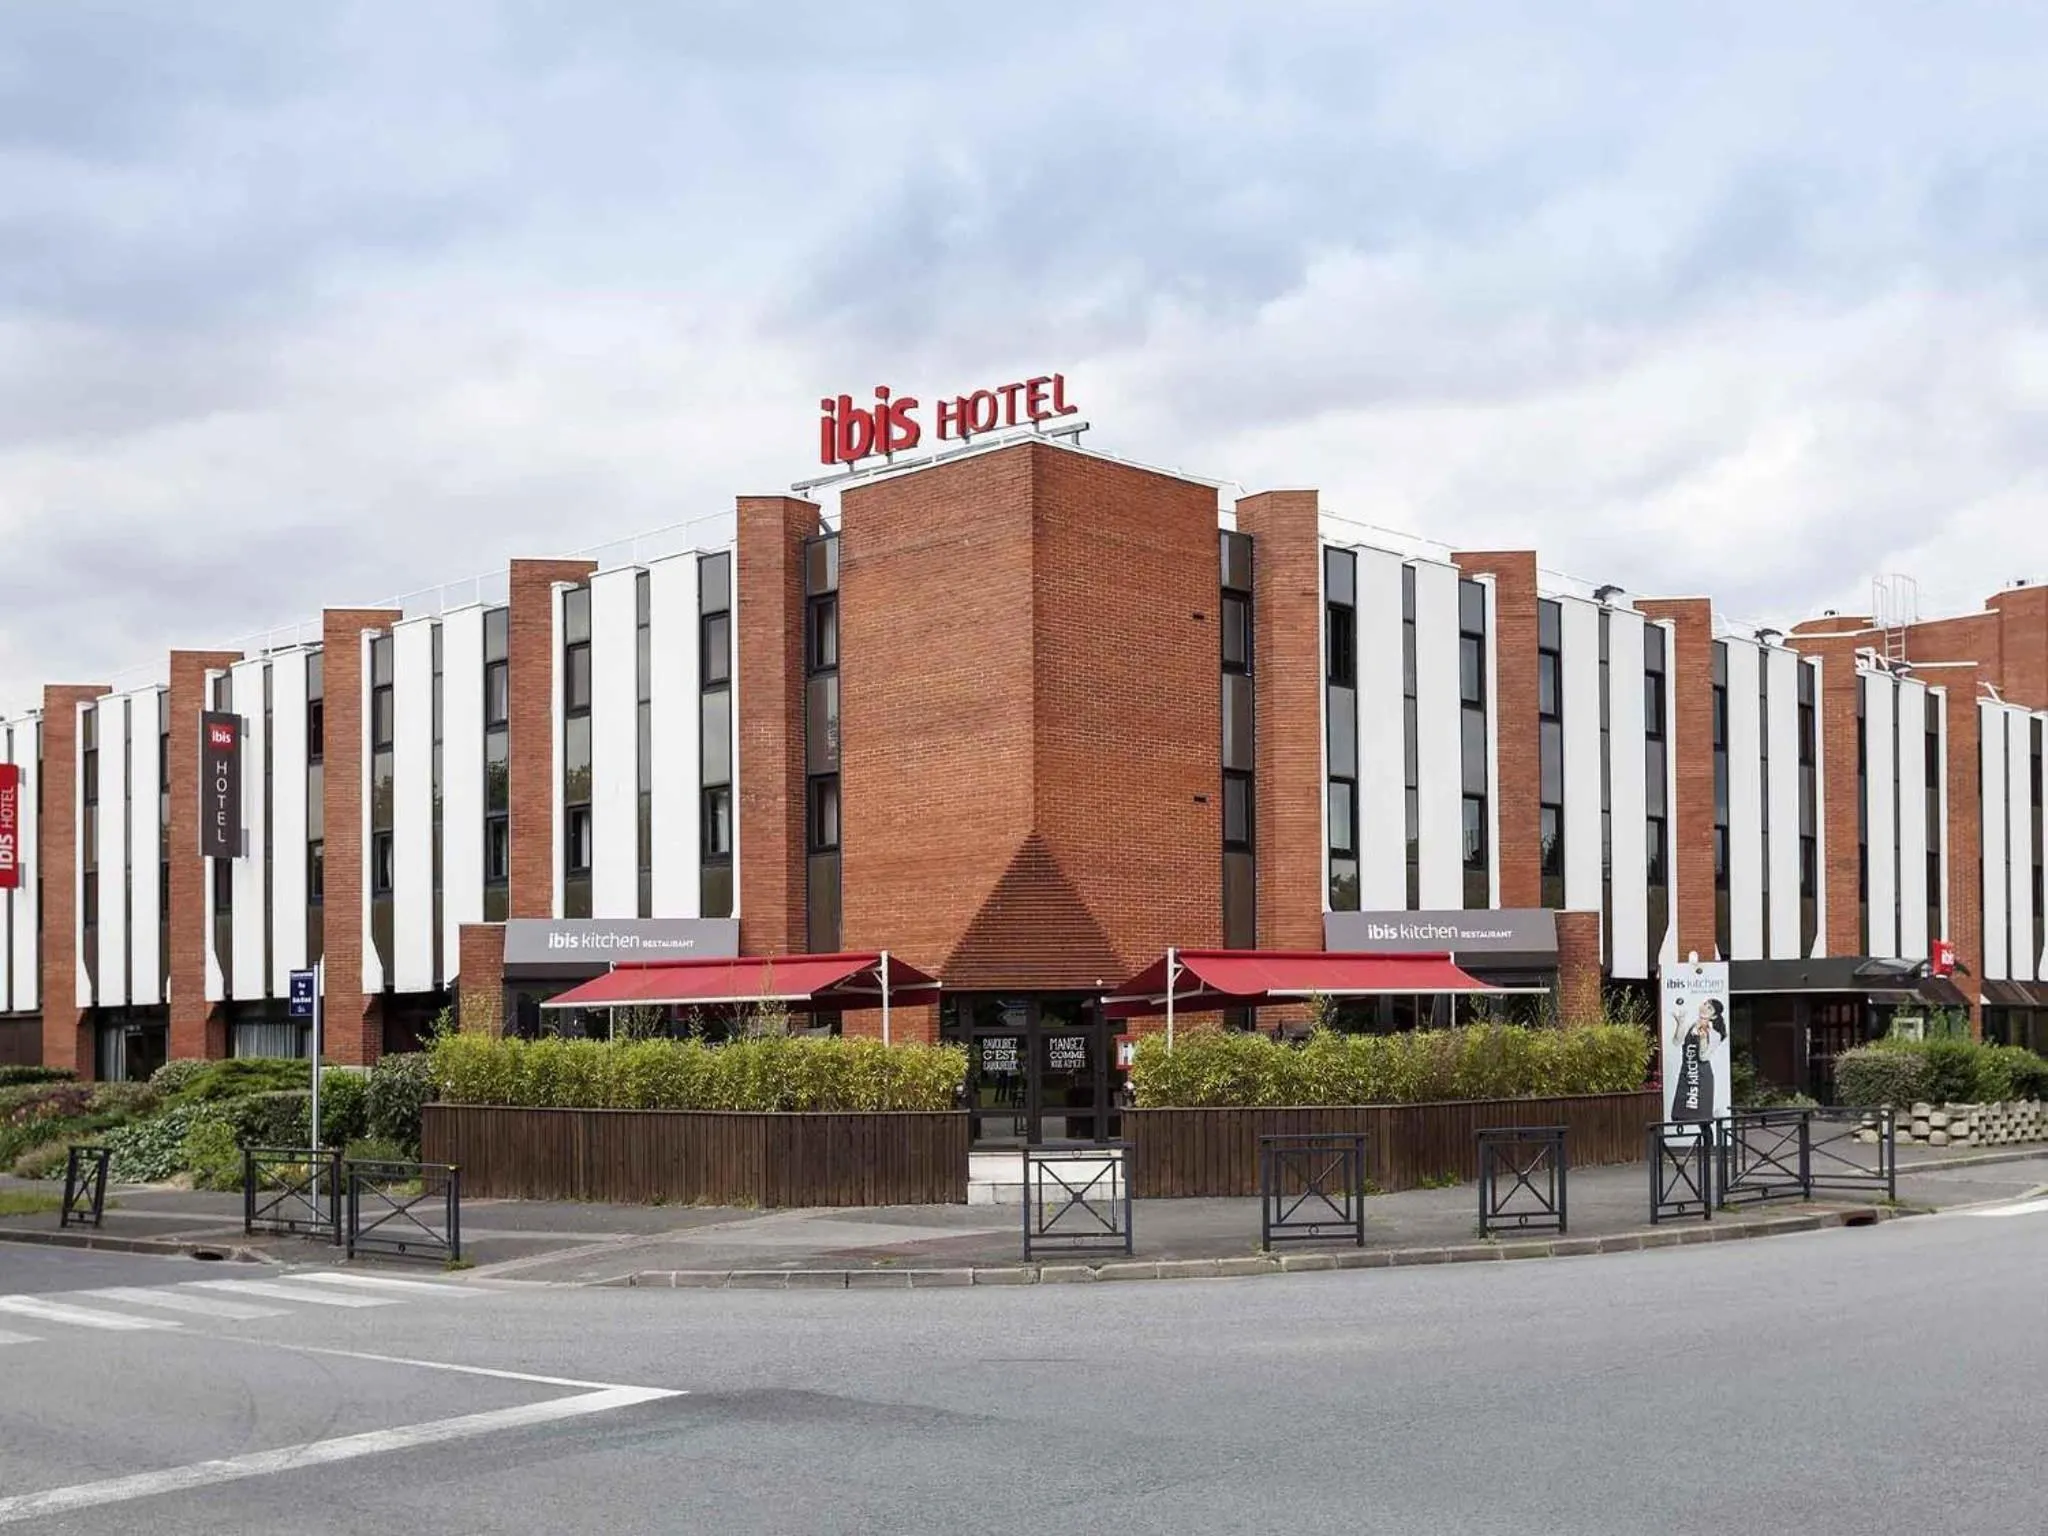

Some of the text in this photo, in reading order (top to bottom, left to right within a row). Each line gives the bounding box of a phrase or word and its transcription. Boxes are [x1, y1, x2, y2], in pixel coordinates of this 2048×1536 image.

[820, 373, 1078, 464] ibis HOTEL
[212, 730, 232, 743] ibis
[1, 785, 14, 829] HOTEL
[216, 761, 228, 843] HOTEL
[1367, 923, 1512, 939] ibis kitchen RESTAURANT
[548, 932, 694, 949] ibis kitchen RESTAURANT
[983, 1050, 1017, 1060] C'EST
[1050, 1051, 1086, 1060] COMME
